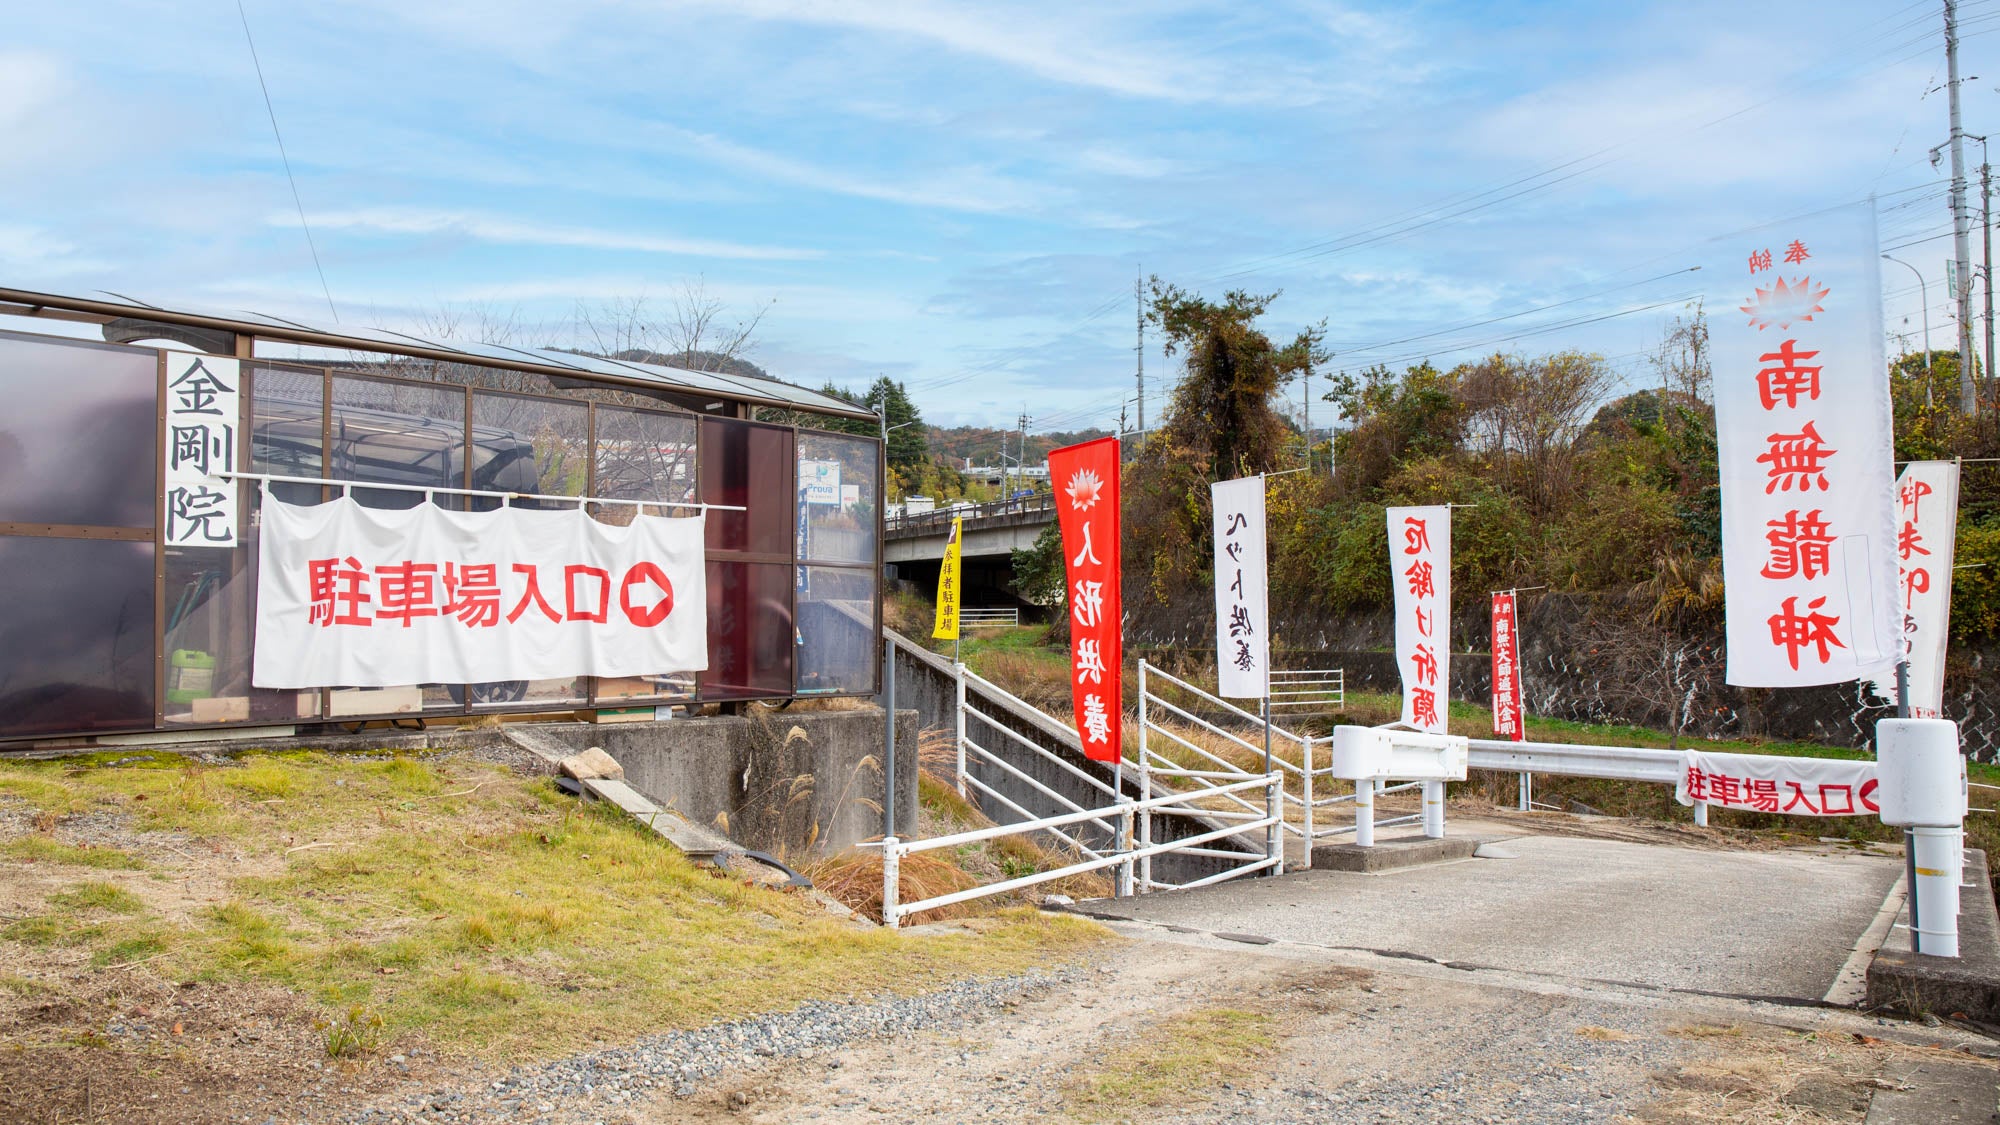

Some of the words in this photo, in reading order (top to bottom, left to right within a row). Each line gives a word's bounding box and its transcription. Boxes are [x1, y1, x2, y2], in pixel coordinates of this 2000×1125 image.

[166, 357, 236, 542] 金剛院
[308, 556, 611, 628] 駐車場入口
[940, 549, 955, 632] 参拝者駐車場
[1495, 619, 1516, 735] 南無大師遍照金剛
[1687, 766, 1855, 814] 駐車場入口
